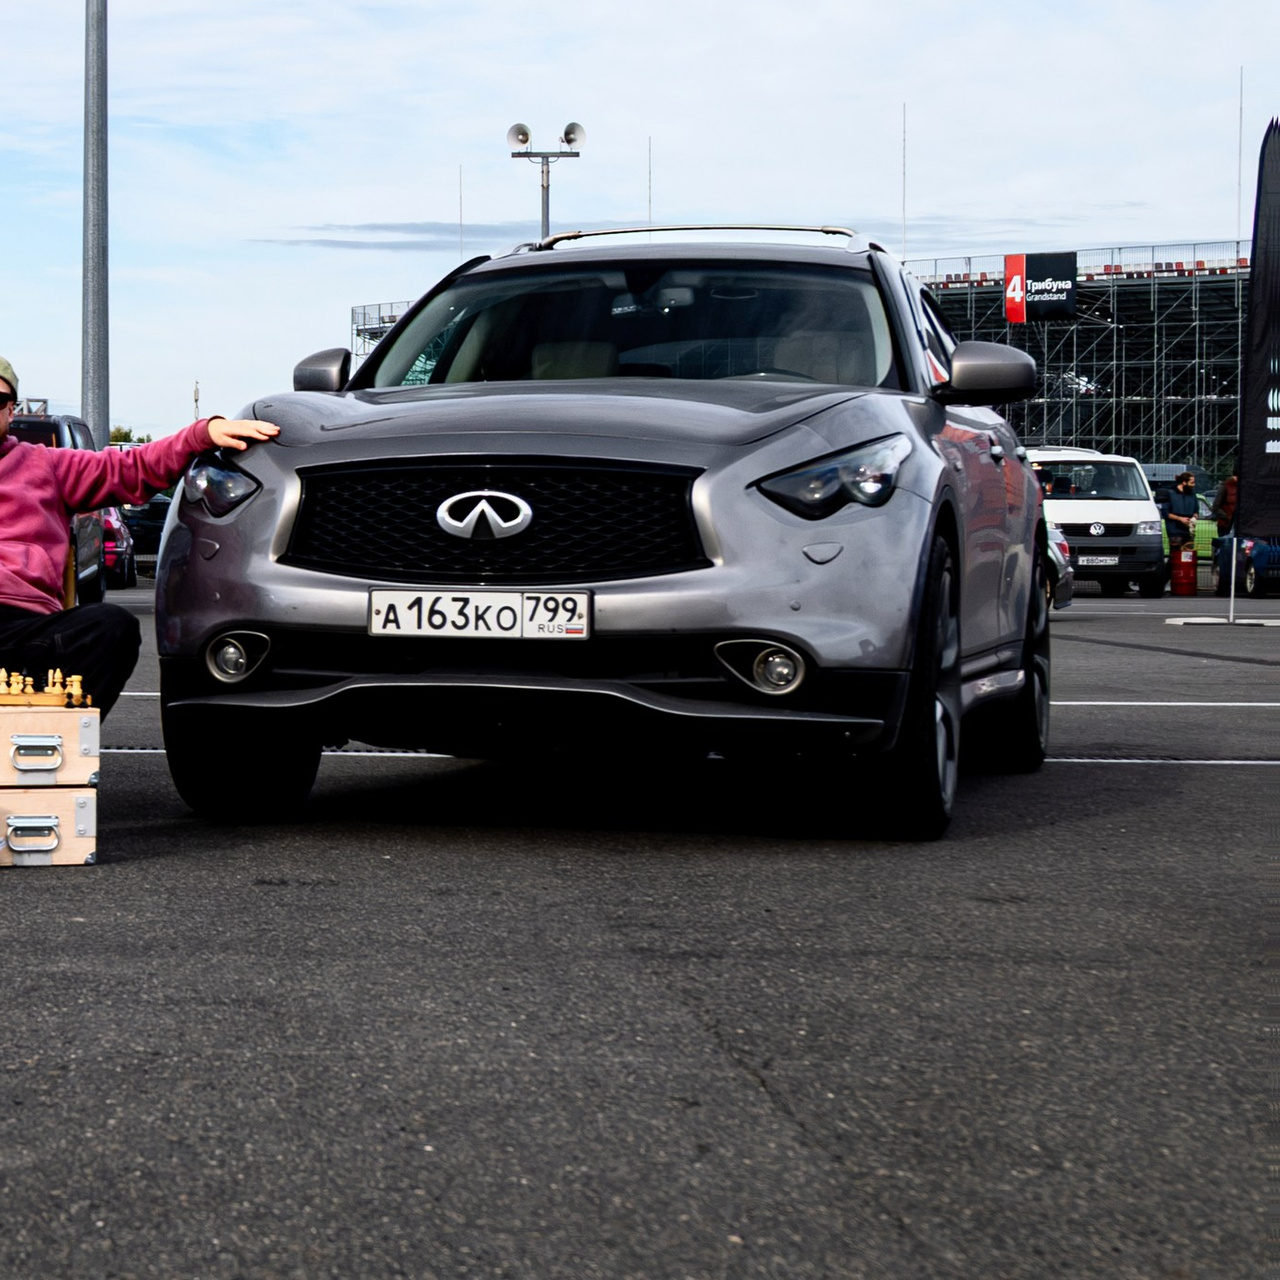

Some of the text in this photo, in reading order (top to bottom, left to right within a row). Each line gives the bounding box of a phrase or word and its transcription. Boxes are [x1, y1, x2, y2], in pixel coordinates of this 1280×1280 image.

[1006, 275, 1023, 302] 4
[1026, 278, 1072, 293] Трибуна
[1026, 292, 1067, 301] Grandstand
[525, 596, 578, 622] 799
[537, 624, 564, 633] RUS
